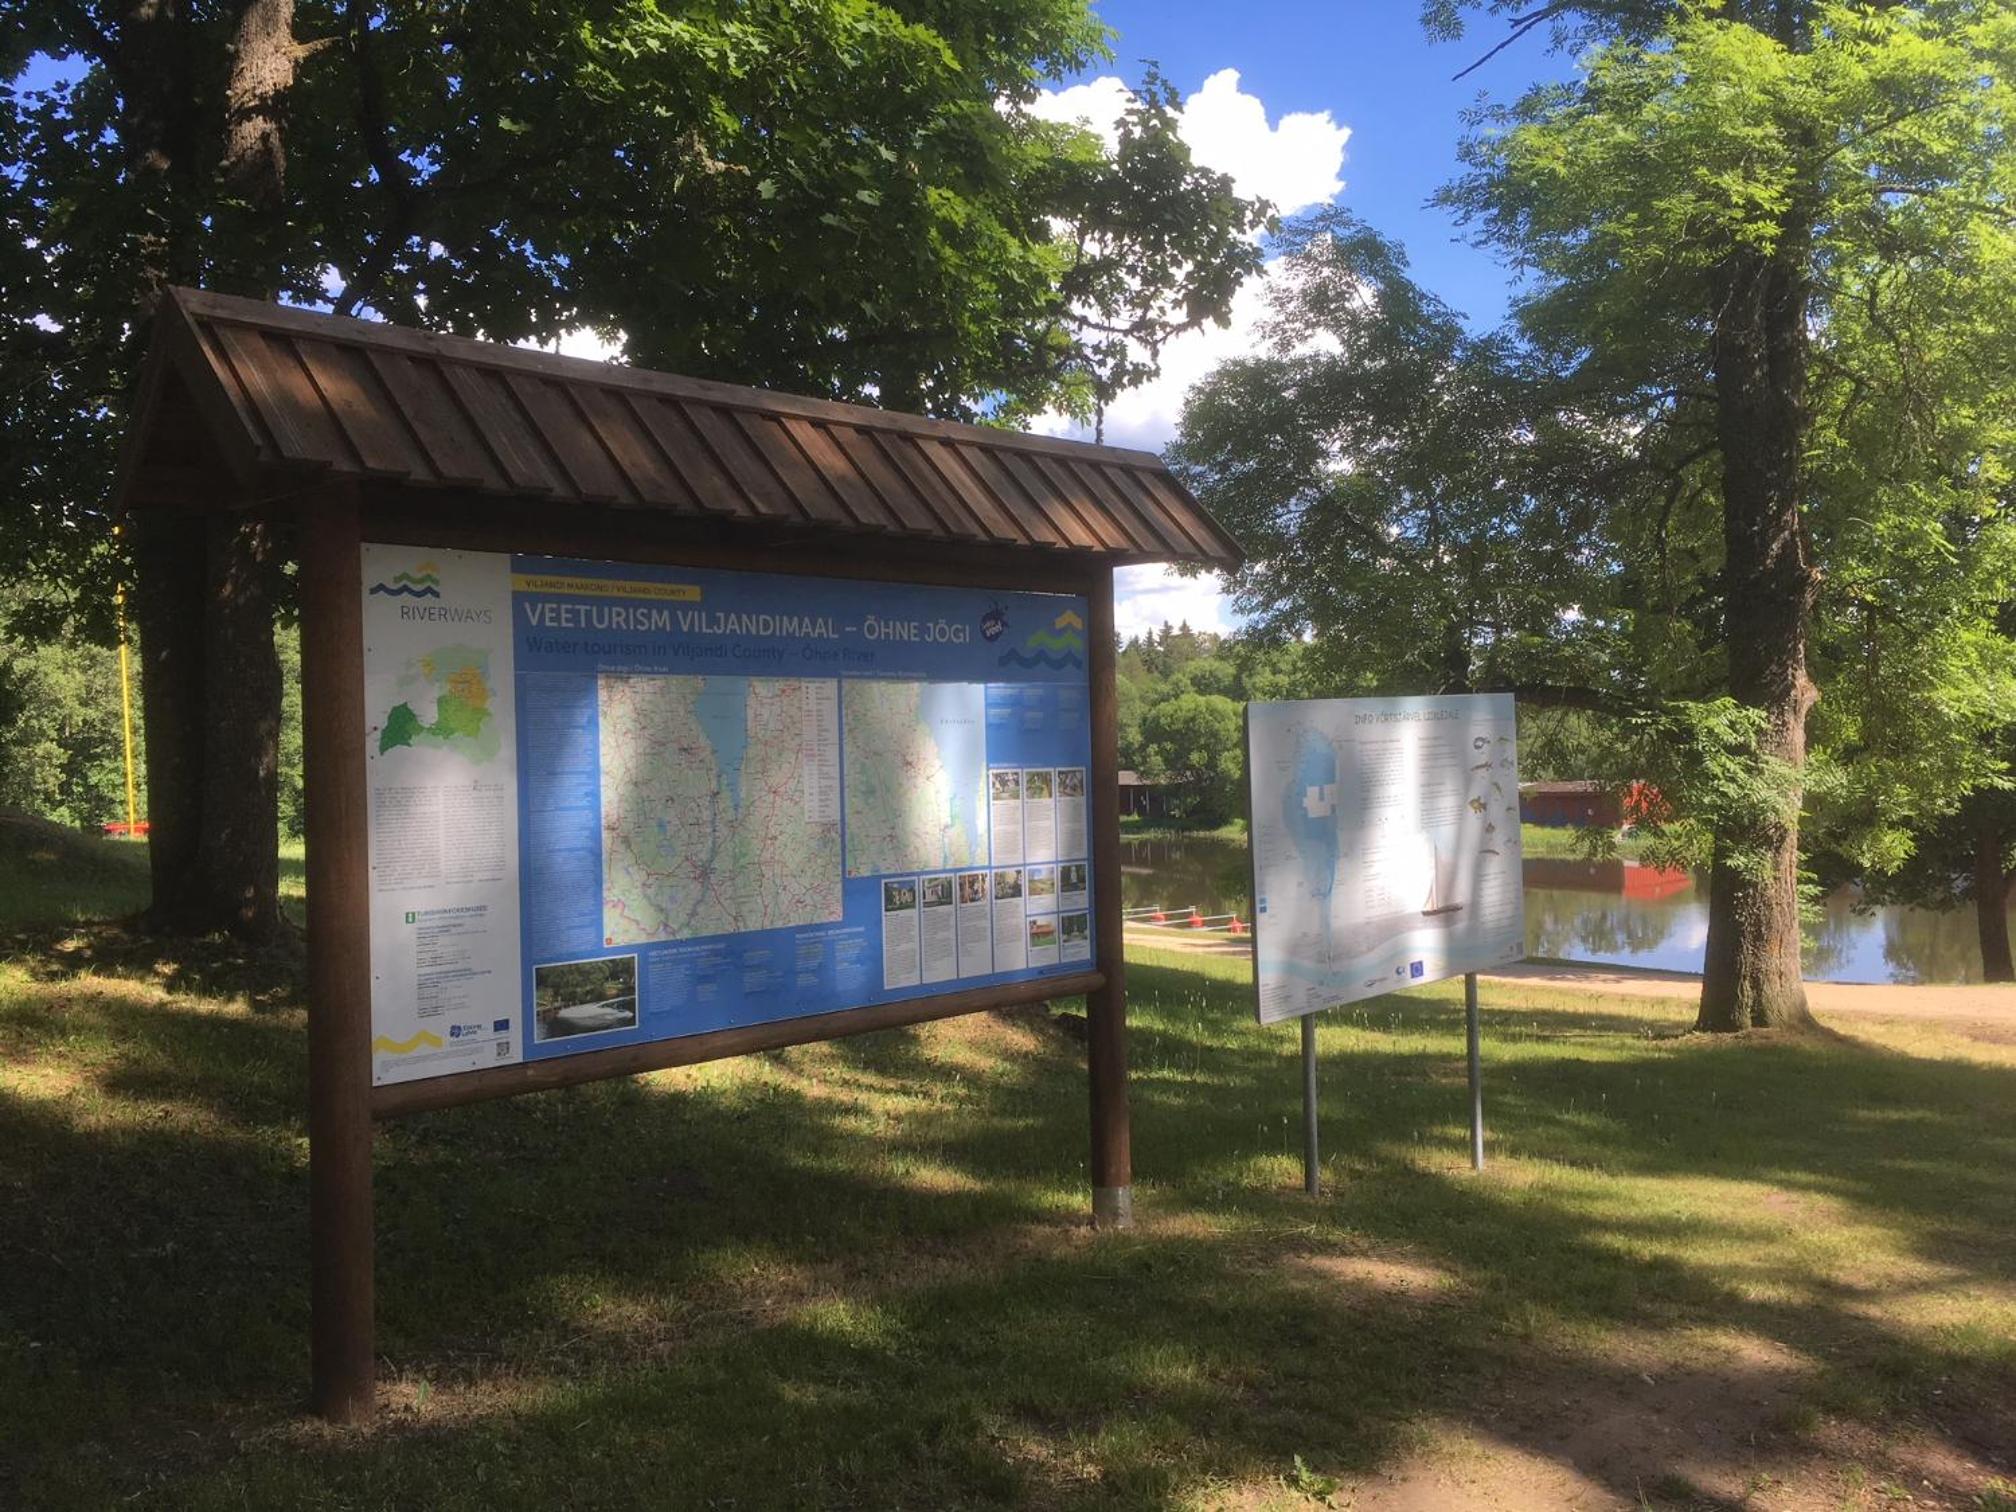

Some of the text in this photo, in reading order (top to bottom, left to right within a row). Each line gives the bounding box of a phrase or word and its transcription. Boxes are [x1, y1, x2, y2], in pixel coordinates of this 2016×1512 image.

[400, 605, 492, 624] RIVERWAYS
[524, 601, 671, 633] VEETURISM
[676, 609, 839, 639] VILJANDIMAAL
[863, 615, 921, 642] ÕHNE
[924, 618, 971, 644] JÕGI
[526, 636, 578, 655] Water
[584, 640, 647, 656] tourism
[654, 641, 667, 657] in
[672, 642, 729, 661] Viljandi
[732, 643, 786, 663] County
